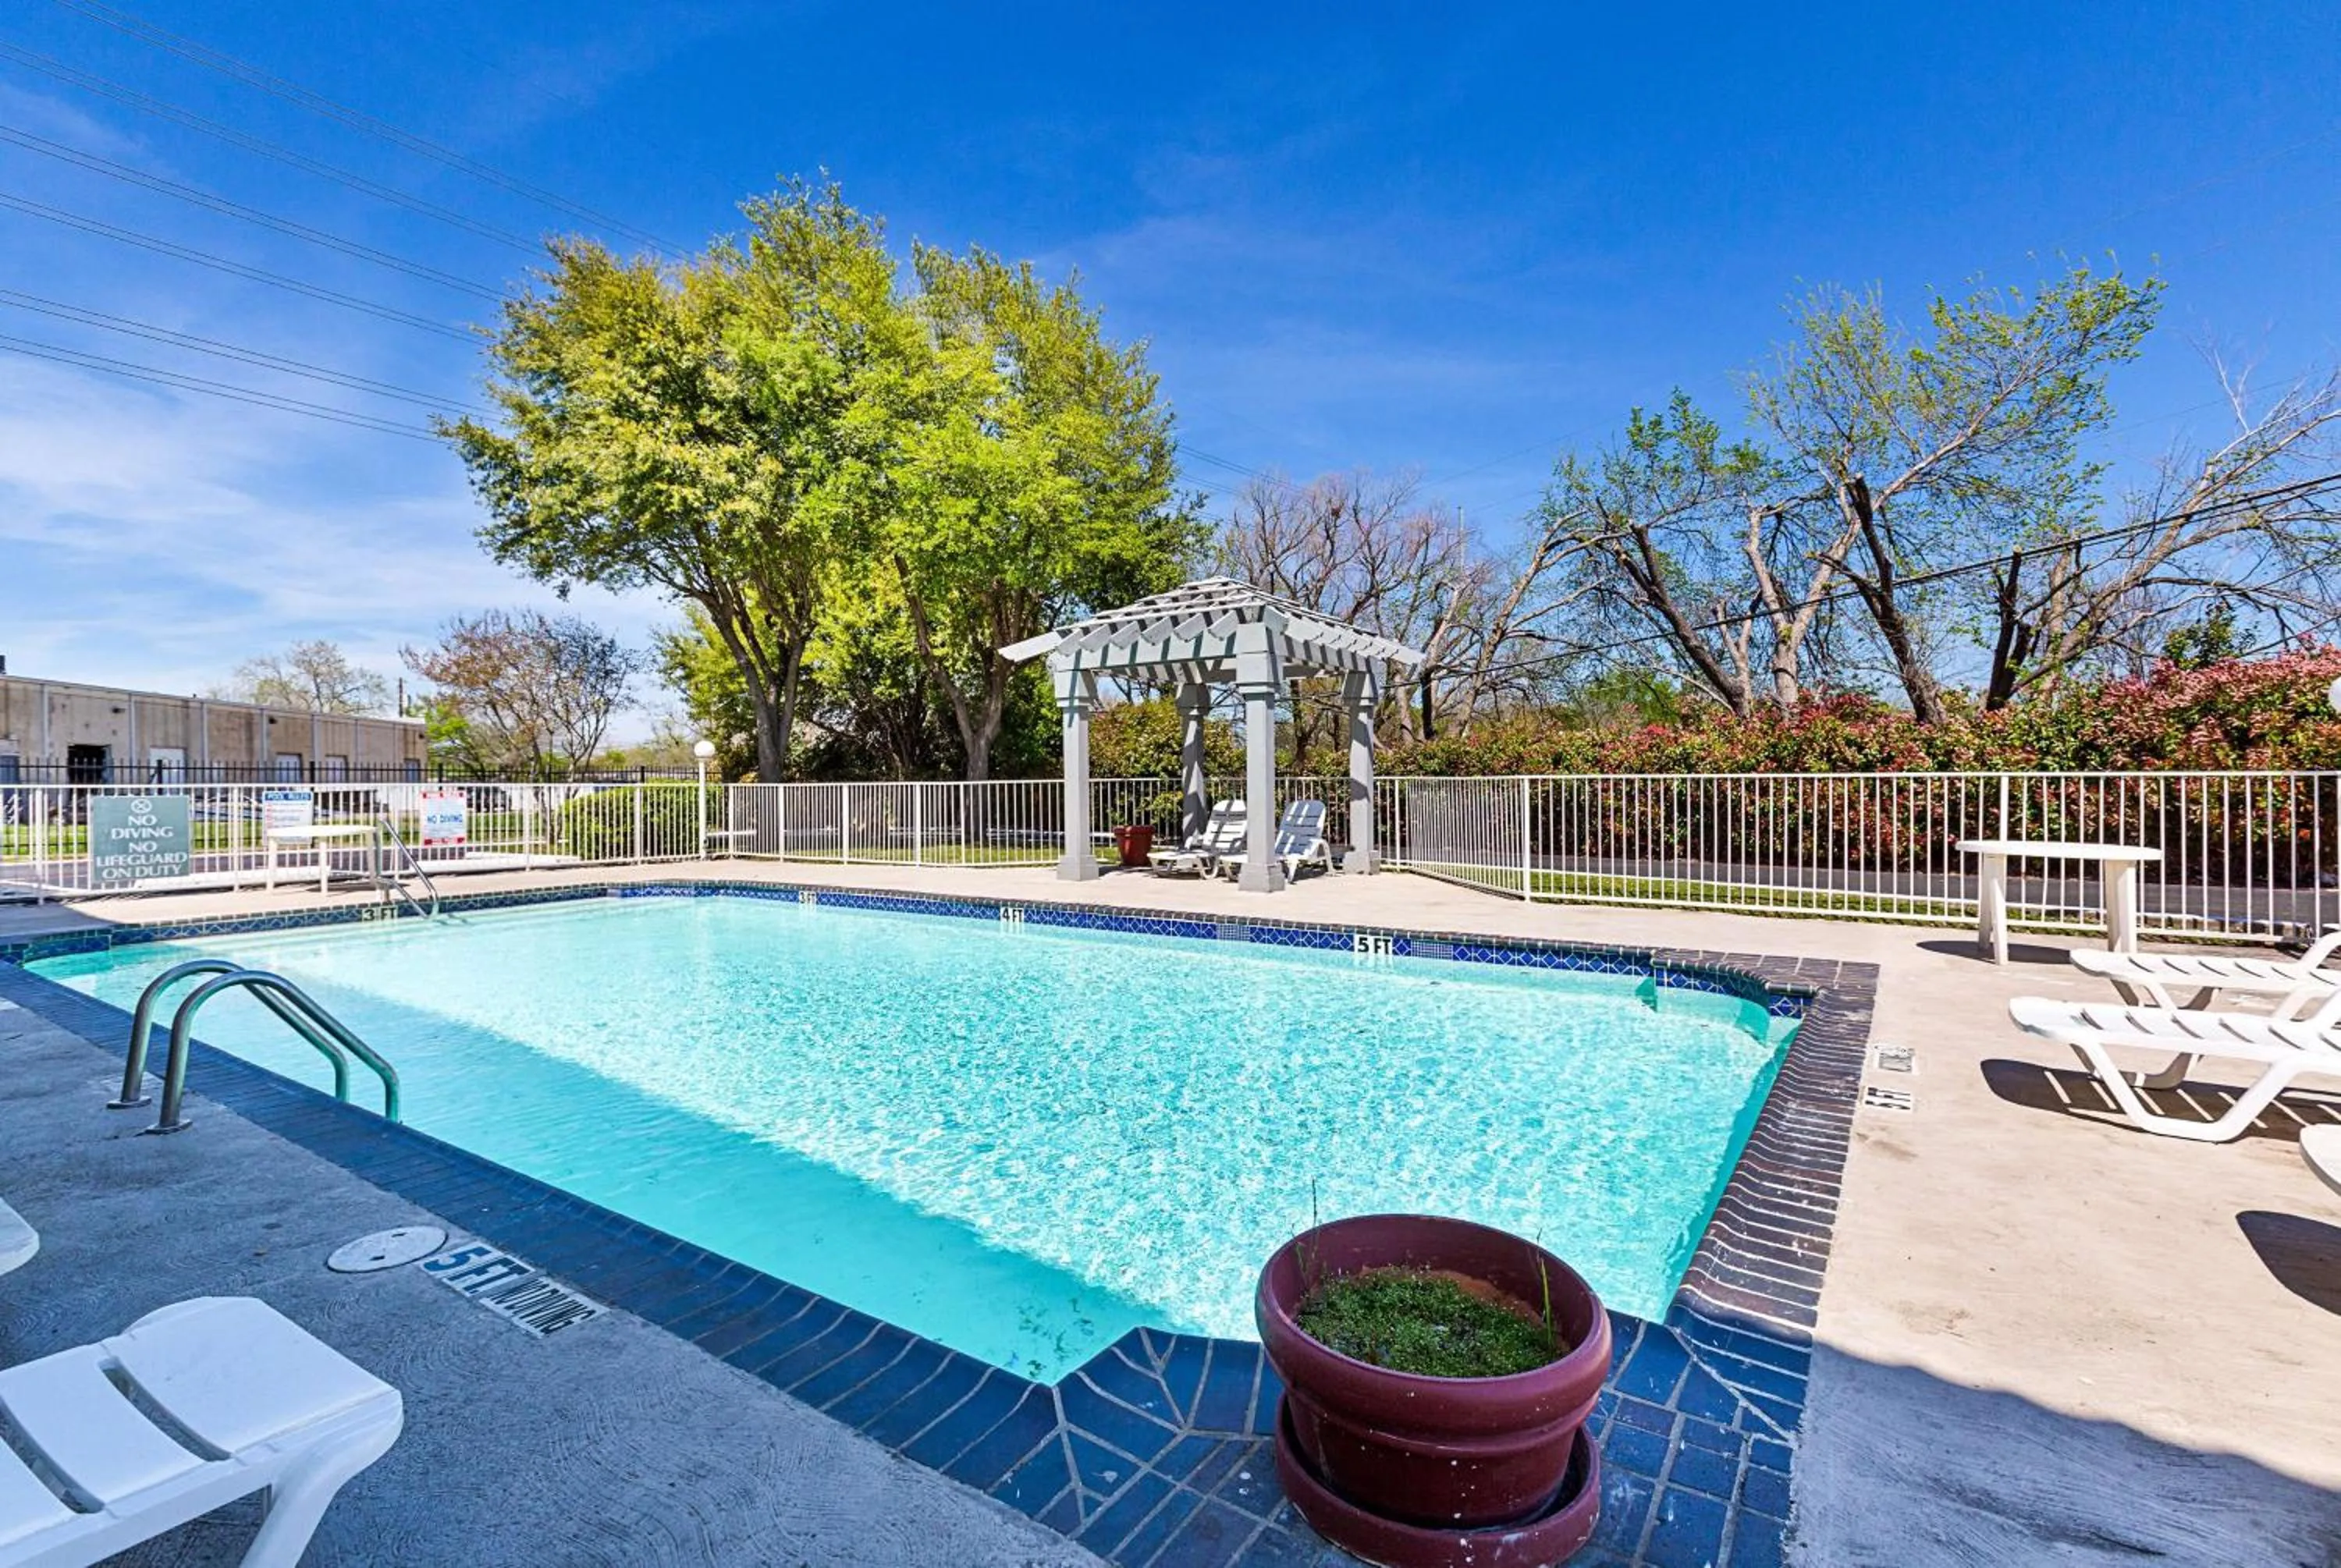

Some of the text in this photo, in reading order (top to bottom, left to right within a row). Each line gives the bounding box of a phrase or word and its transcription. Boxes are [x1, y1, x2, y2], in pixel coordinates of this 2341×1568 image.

[127, 814, 157, 826] NO
[427, 814, 463, 824] NO DIVING
[111, 826, 174, 840] DIVING
[128, 840, 158, 853] NO
[95, 851, 188, 867] LIFEGUARD
[101, 864, 182, 880] ON DUTY
[364, 907, 397, 921] 3 FT
[1002, 907, 1023, 923] 4 FT
[1357, 937, 1391, 955] 5 FT
[423, 1246, 492, 1272] 5
[485, 1278, 550, 1304] NO
[503, 1287, 597, 1335] DIVING
